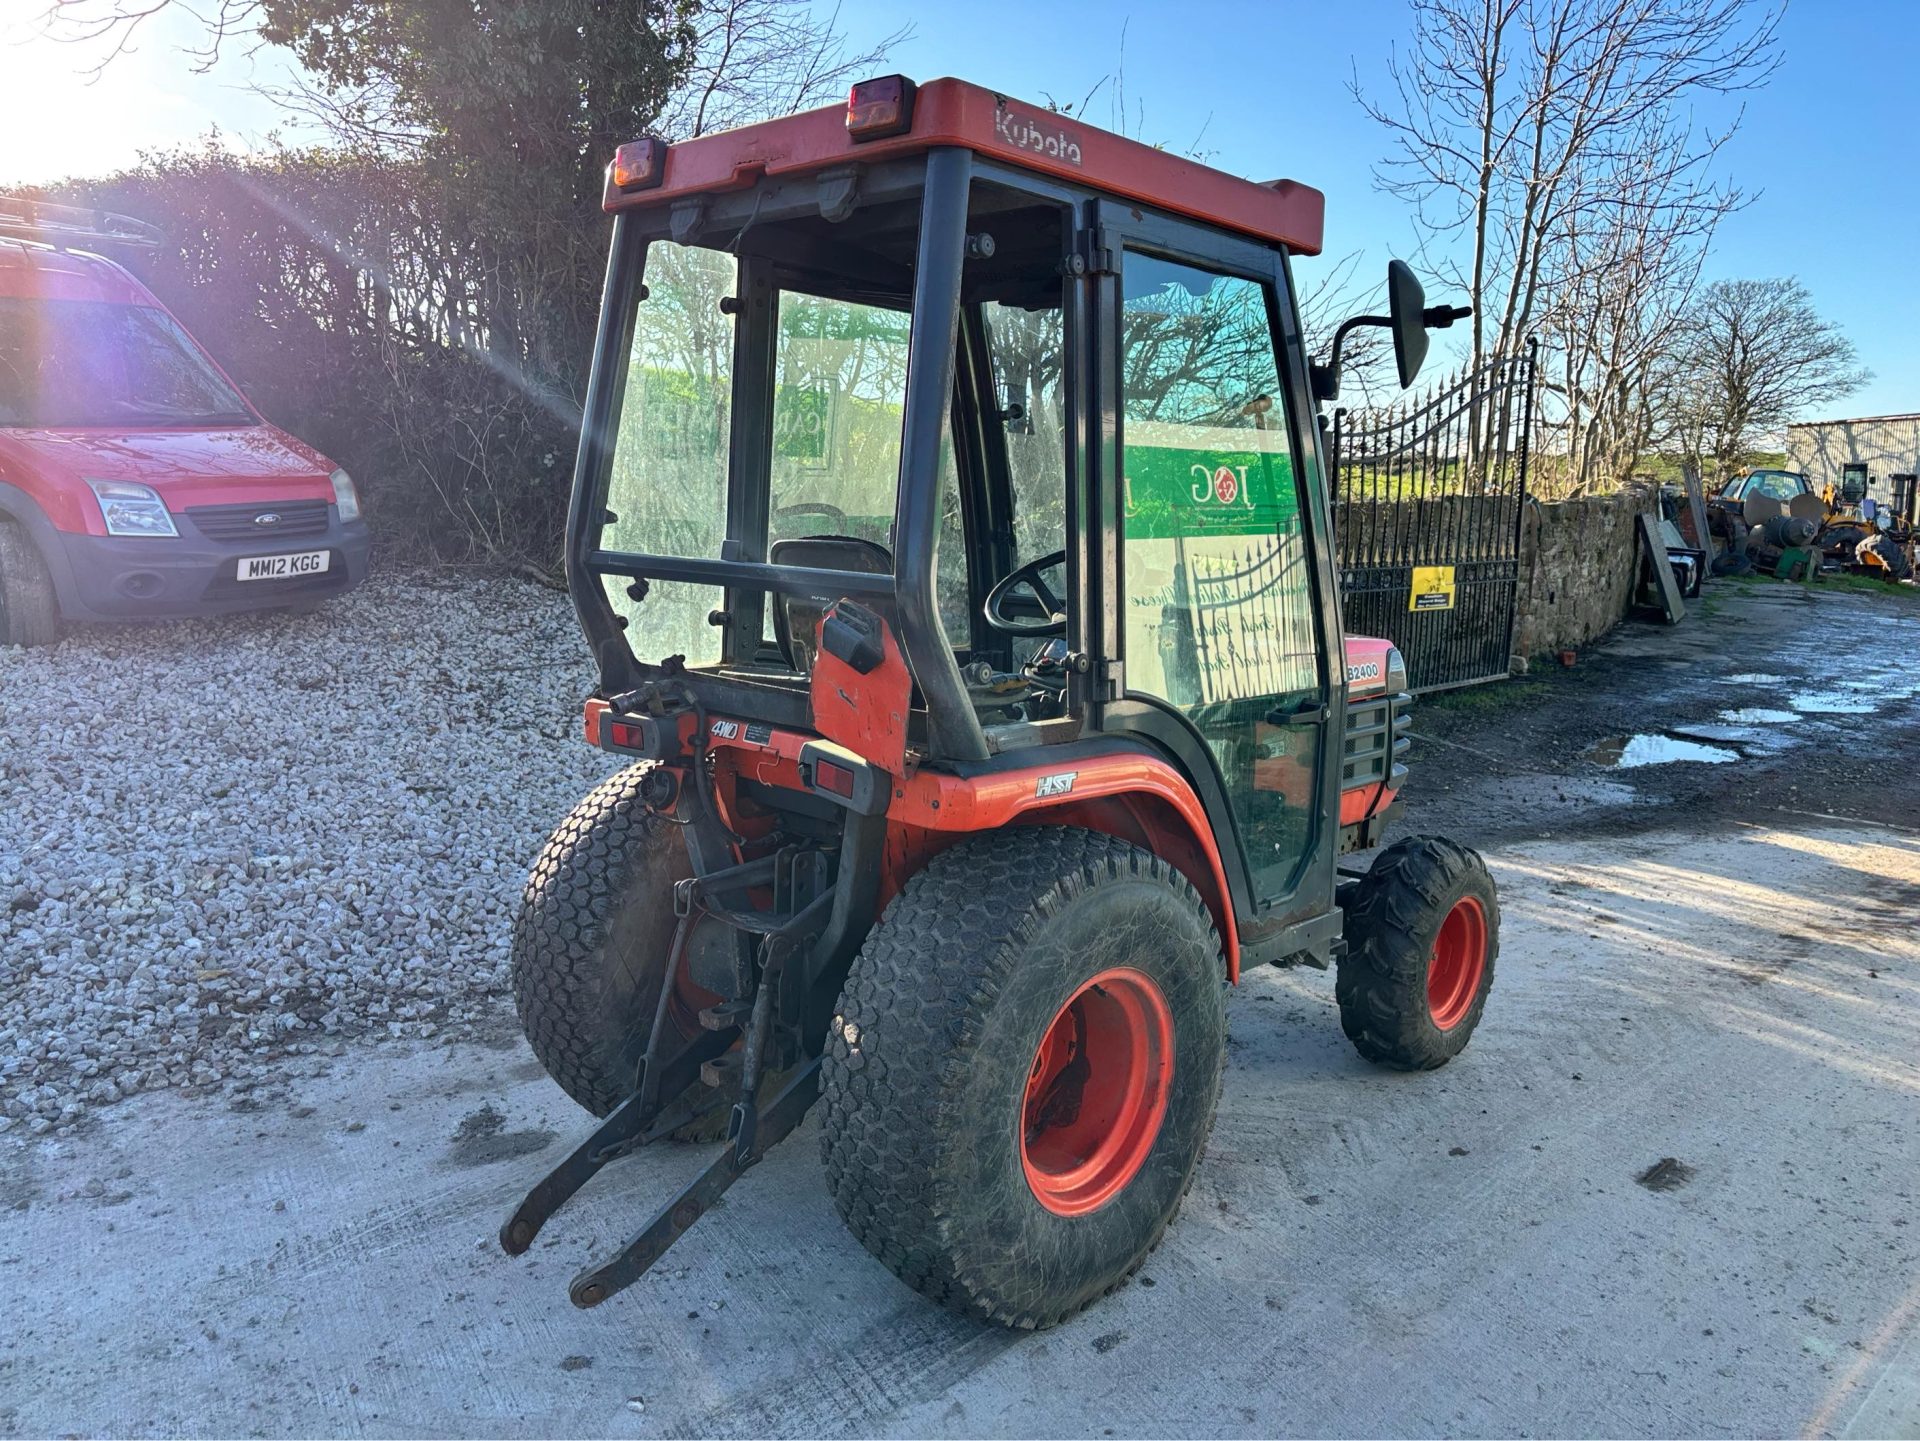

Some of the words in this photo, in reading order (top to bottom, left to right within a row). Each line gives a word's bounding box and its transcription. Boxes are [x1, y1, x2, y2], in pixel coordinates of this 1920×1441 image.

[996, 109, 1081, 165] Kubota
[249, 558, 286, 577] MM12
[290, 554, 320, 573] KGG
[711, 720, 739, 740] 4WD
[1035, 771, 1078, 798] HST
